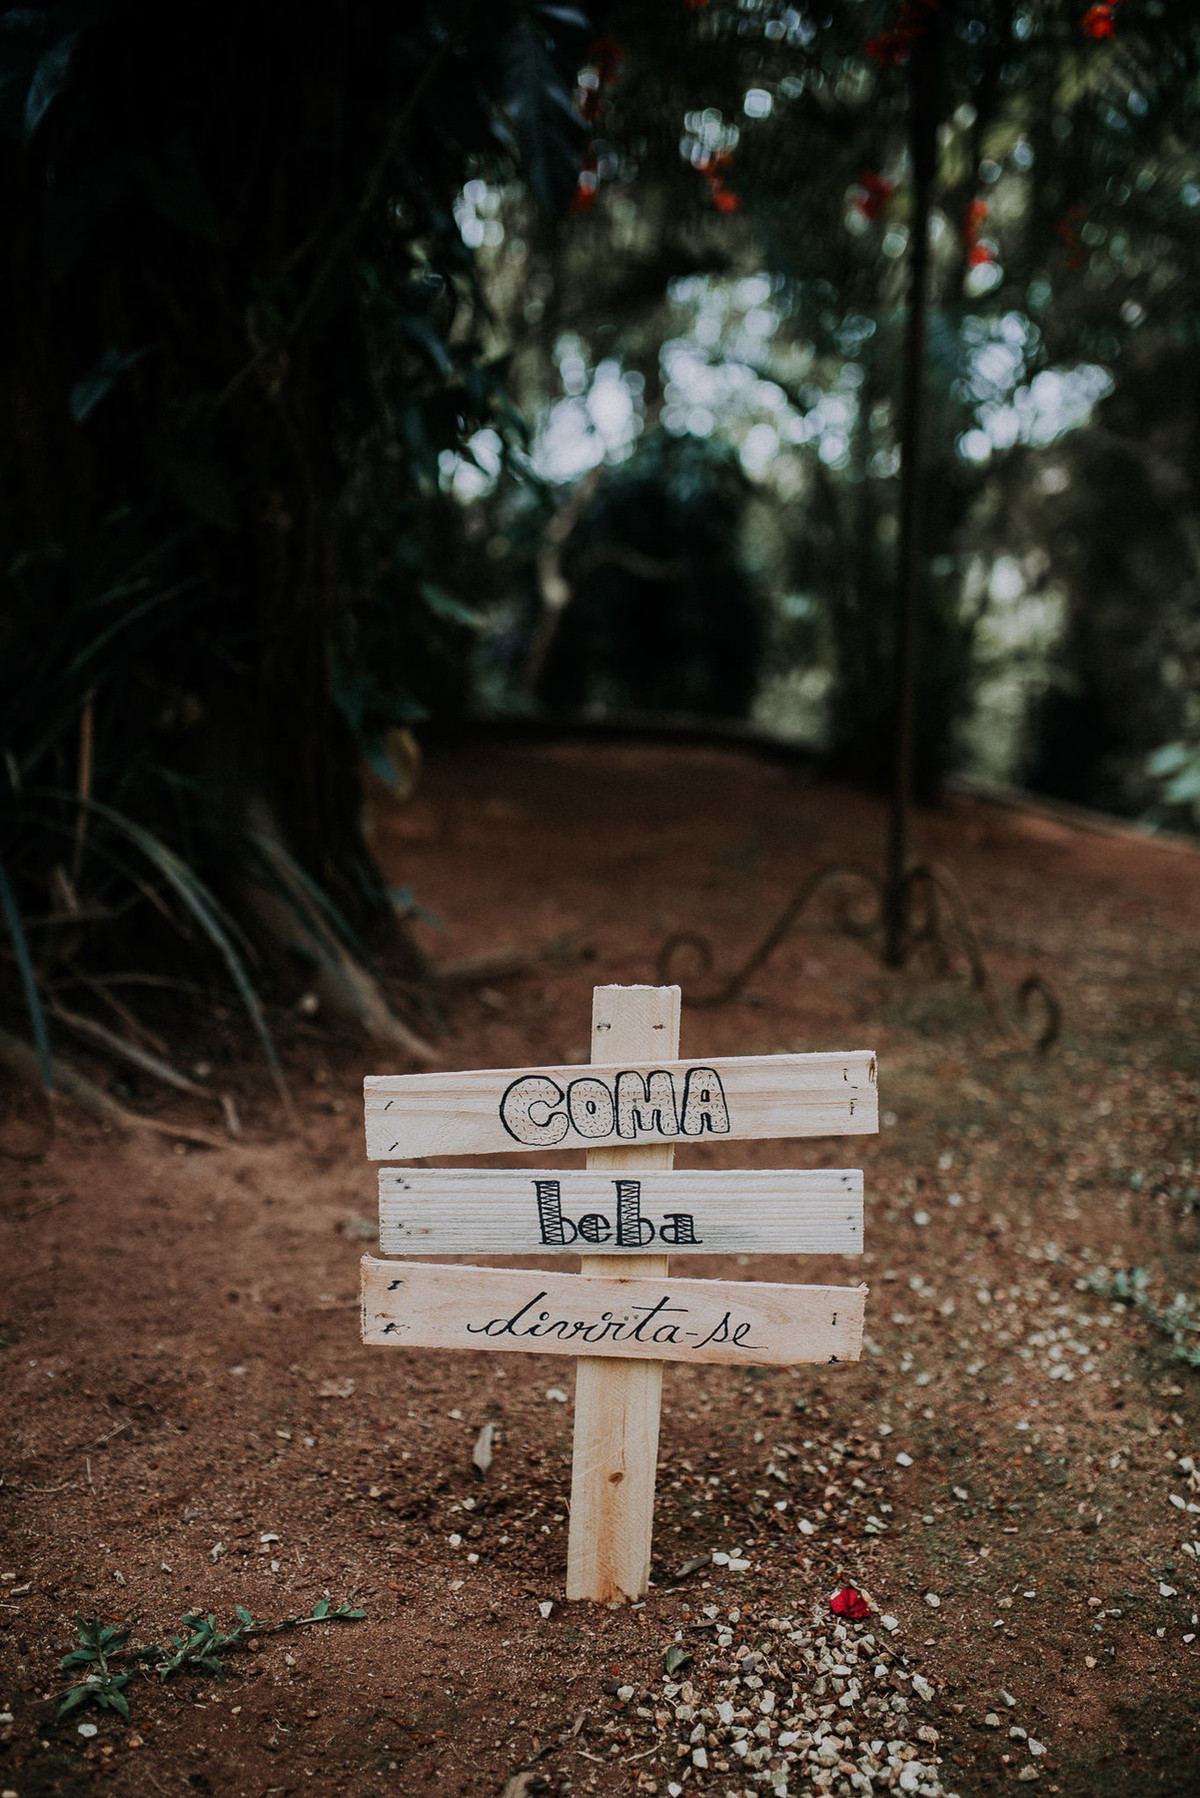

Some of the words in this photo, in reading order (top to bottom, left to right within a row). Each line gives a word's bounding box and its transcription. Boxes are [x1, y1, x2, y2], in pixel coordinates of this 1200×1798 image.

[499, 1066, 731, 1147] COMA
[531, 1180, 703, 1247] beba
[467, 1291, 769, 1350] divirta-se
